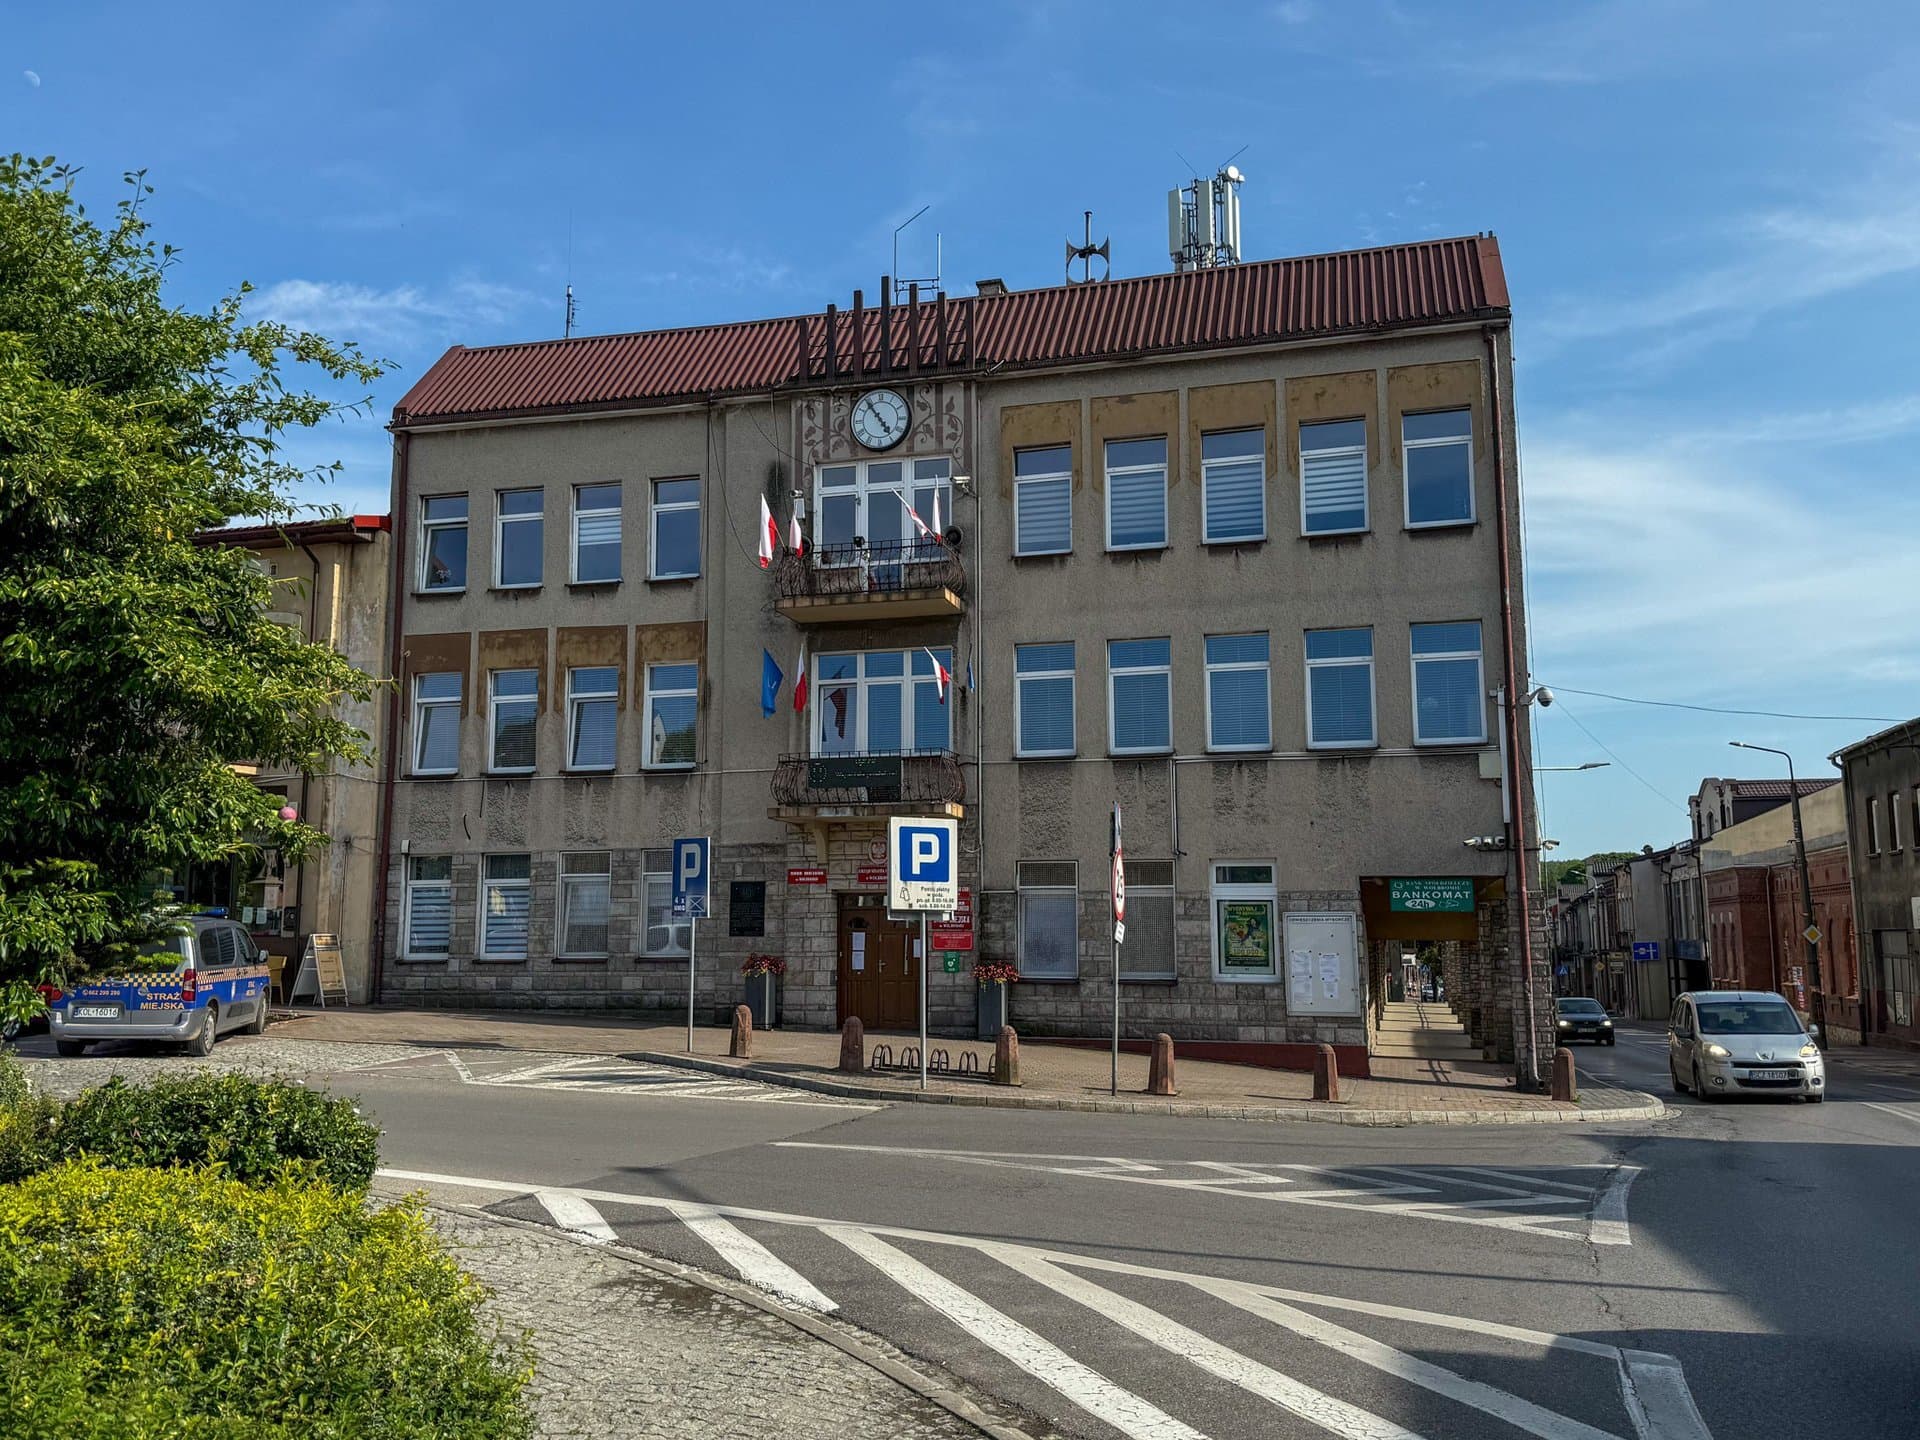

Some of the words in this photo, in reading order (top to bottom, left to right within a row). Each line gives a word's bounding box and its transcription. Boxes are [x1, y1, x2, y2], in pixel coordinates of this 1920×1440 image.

[912, 833, 940, 875] P
[680, 843, 701, 892] P
[140, 1002, 185, 1010] MIEJSKA
[146, 991, 180, 1000] STRAŻ
